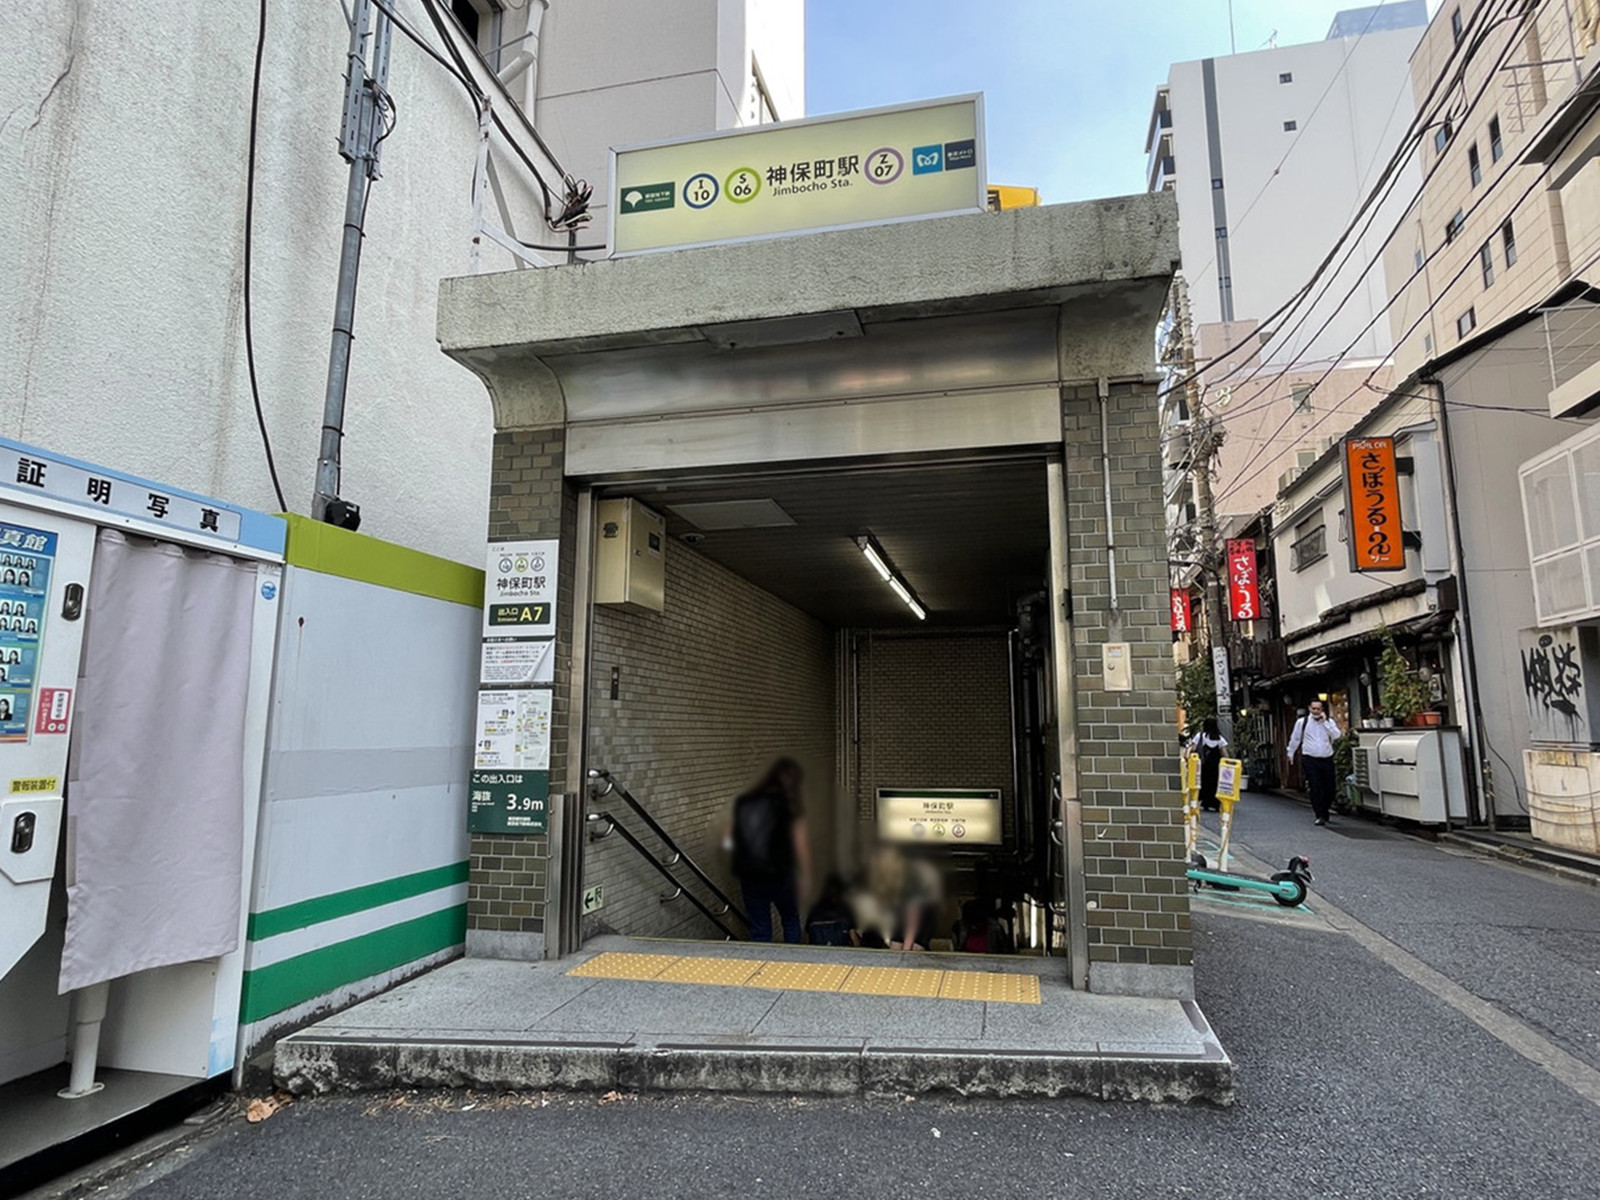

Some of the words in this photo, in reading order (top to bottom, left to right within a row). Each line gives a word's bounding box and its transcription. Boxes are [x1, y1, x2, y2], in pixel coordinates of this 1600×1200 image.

[880, 153, 888, 164] Z
[766, 155, 859, 186] 神保町駅
[874, 164, 893, 177] 07
[698, 179, 704, 189] I
[739, 173, 747, 184] S
[733, 184, 752, 196] 06
[772, 181, 827, 196] Jimbocho
[831, 178, 853, 189] Sta.
[694, 189, 710, 201] 10
[16, 457, 221, 533] 証明写真
[0, 527, 48, 552] 真館
[497, 576, 546, 590] 神保町駅
[1234, 556, 1254, 619] さぼうる
[498, 607, 519, 616] 出入口
[520, 606, 544, 622] A7
[472, 773, 524, 784] この出入口は
[472, 790, 492, 801] 海抜
[506, 793, 545, 811] 3.9m
